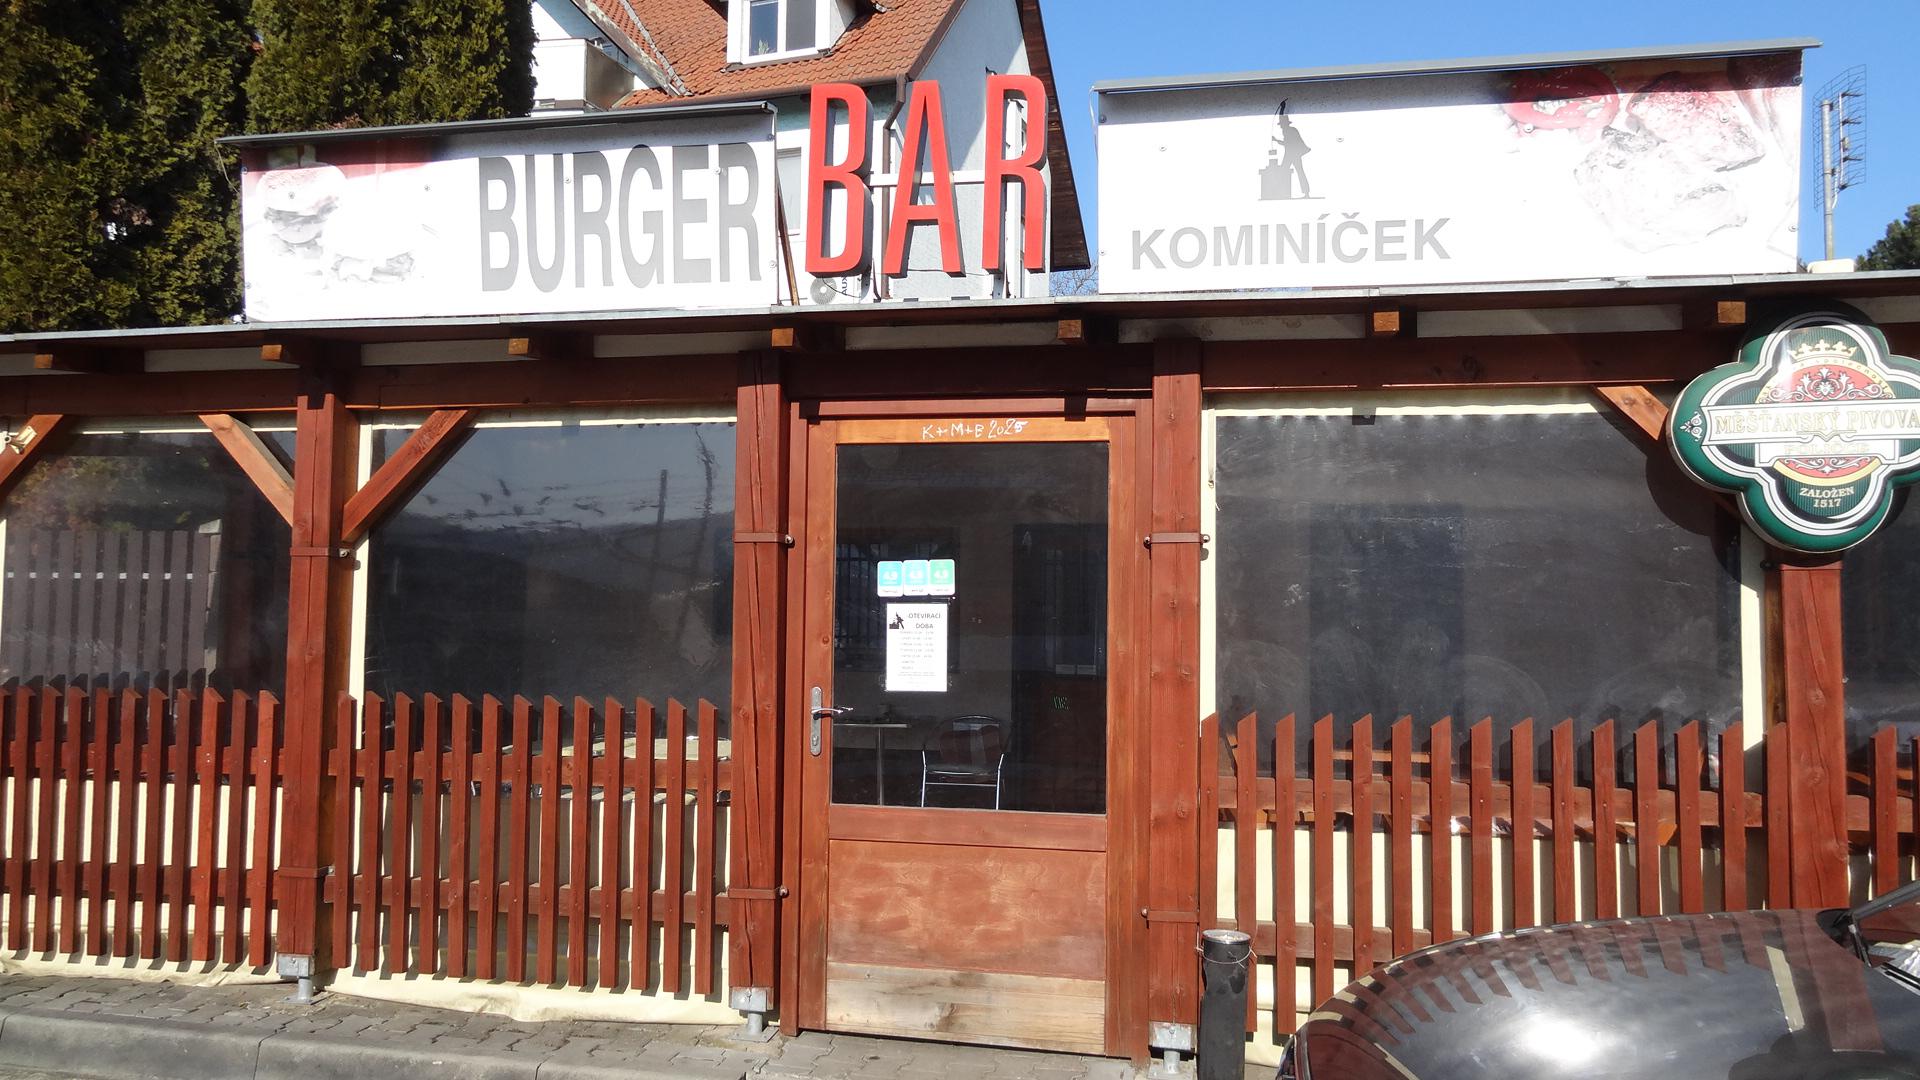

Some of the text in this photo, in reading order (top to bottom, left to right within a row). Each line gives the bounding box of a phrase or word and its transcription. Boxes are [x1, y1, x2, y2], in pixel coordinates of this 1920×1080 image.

[479, 74, 1047, 293] BURGER BAR
[1131, 212, 1451, 270] KOMINÍČEK
[988, 418, 1028, 439] 2025
[1799, 486, 1855, 499] ZALOŽEN
[1813, 498, 1841, 508] 1517
